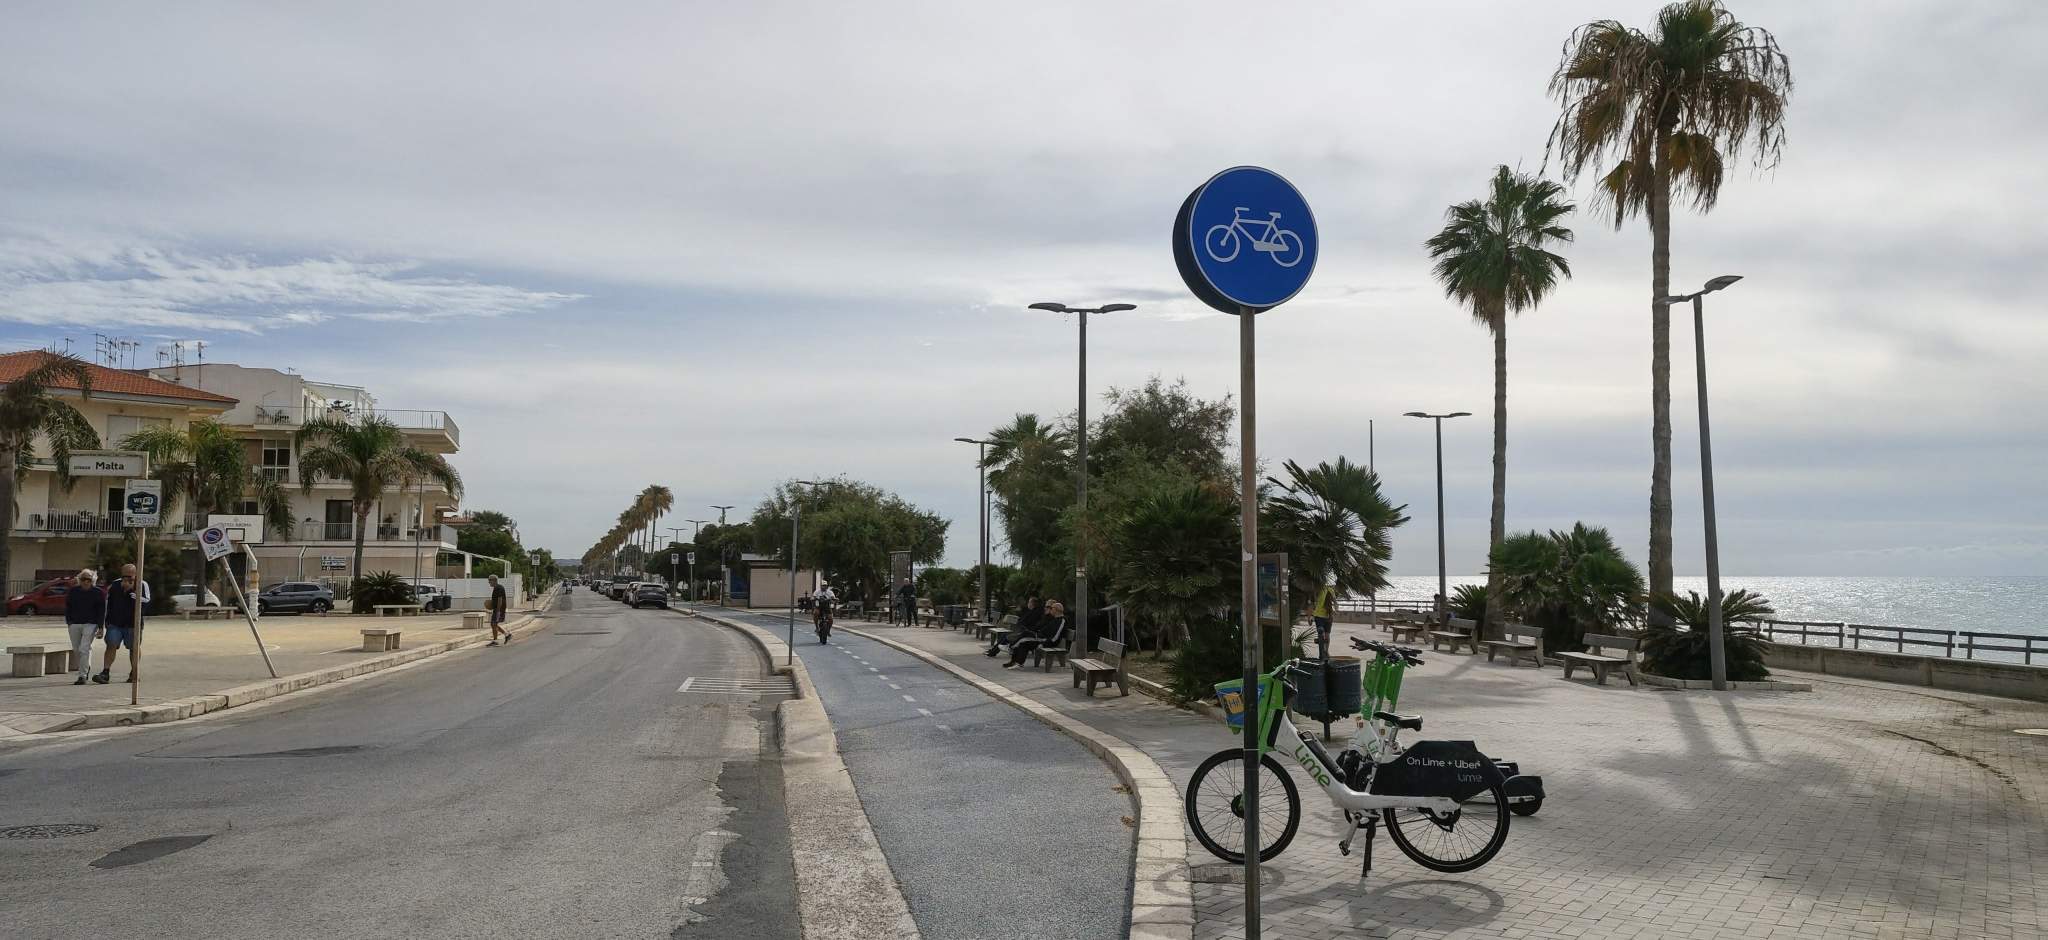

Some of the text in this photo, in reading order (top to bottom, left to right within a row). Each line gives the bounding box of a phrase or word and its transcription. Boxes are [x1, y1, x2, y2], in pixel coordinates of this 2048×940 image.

[95, 461, 125, 470] Malta
[1295, 744, 1331, 787] Lime
[1406, 756, 1420, 766] On
[1422, 757, 1445, 767] Lime
